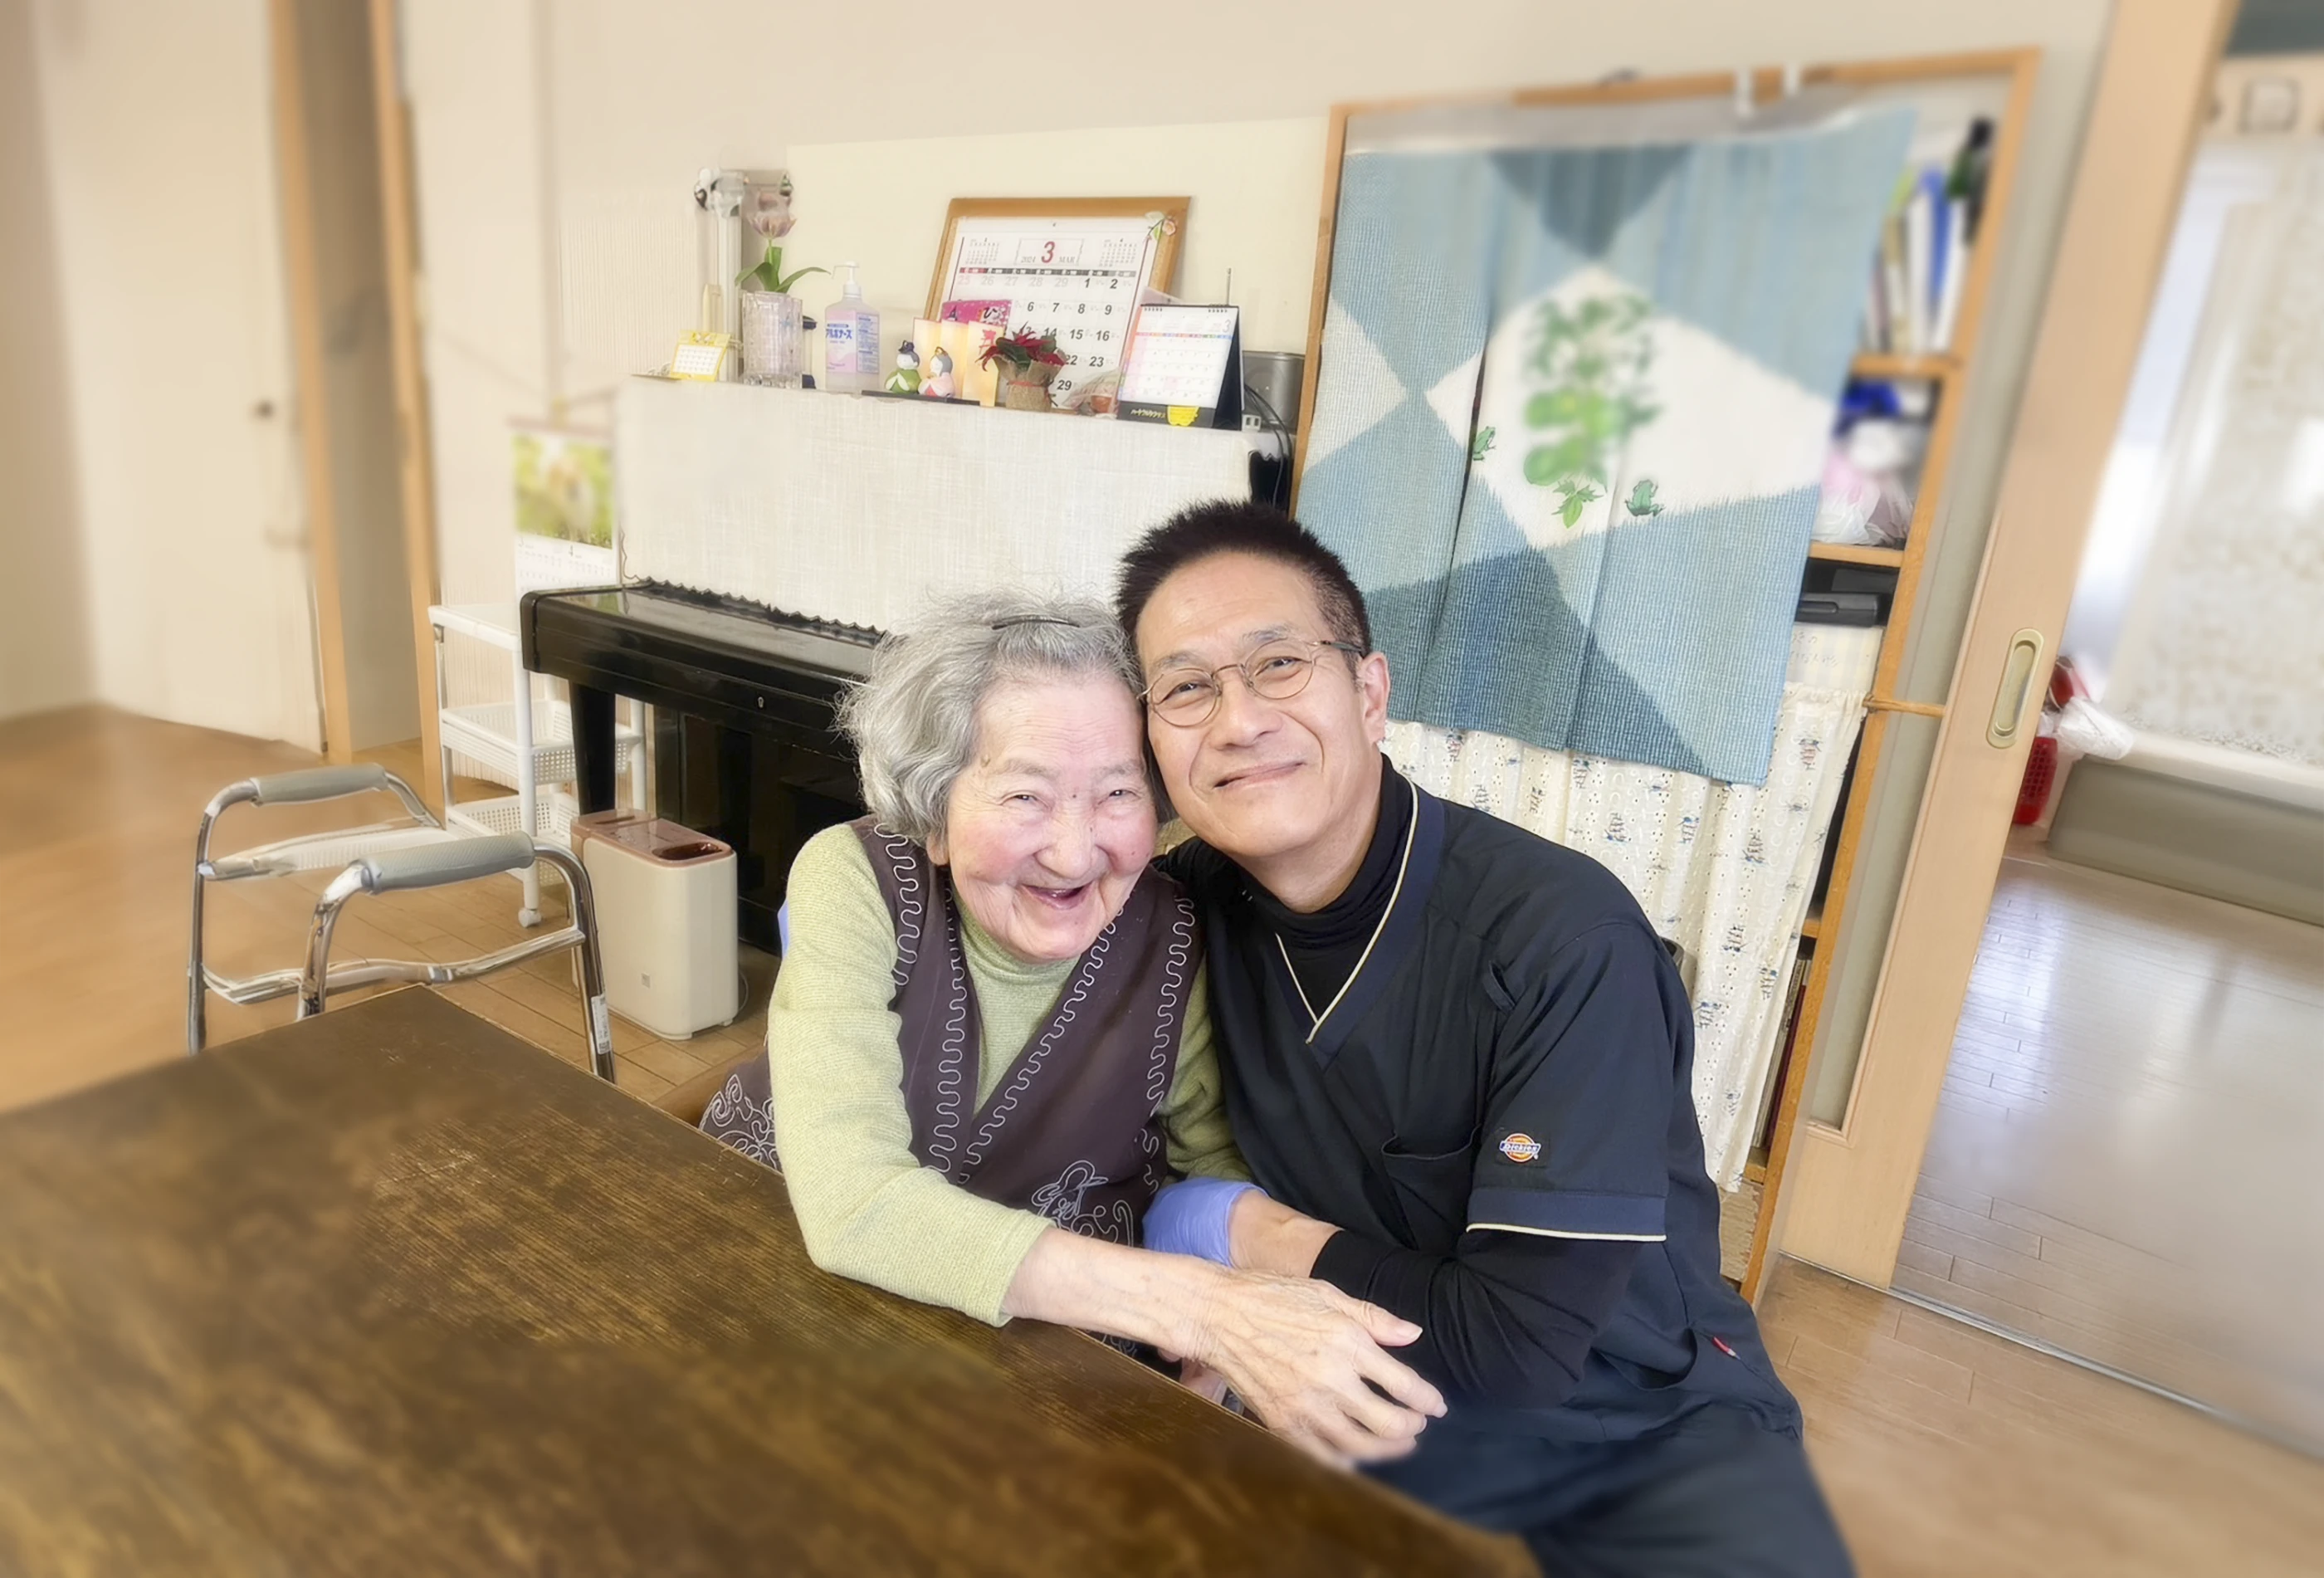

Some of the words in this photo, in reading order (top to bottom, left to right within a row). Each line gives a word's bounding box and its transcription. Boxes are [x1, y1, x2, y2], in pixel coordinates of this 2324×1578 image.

[1041, 241, 1055, 264] 3
[981, 276, 994, 286] 26
[1004, 276, 1018, 286] 27
[1028, 277, 1043, 287] 28
[1054, 277, 1068, 288] 29
[1084, 278, 1091, 288] 1
[1110, 279, 1118, 289] 2
[1027, 301, 1035, 312] 6
[1052, 302, 1060, 313] 7
[1077, 303, 1086, 315] 8
[1104, 304, 1112, 315] 9
[1043, 327, 1057, 337] 14
[1069, 329, 1084, 340] 15
[1096, 330, 1110, 341] 16
[1089, 356, 1104, 368] 23
[1057, 379, 1072, 391] 29
